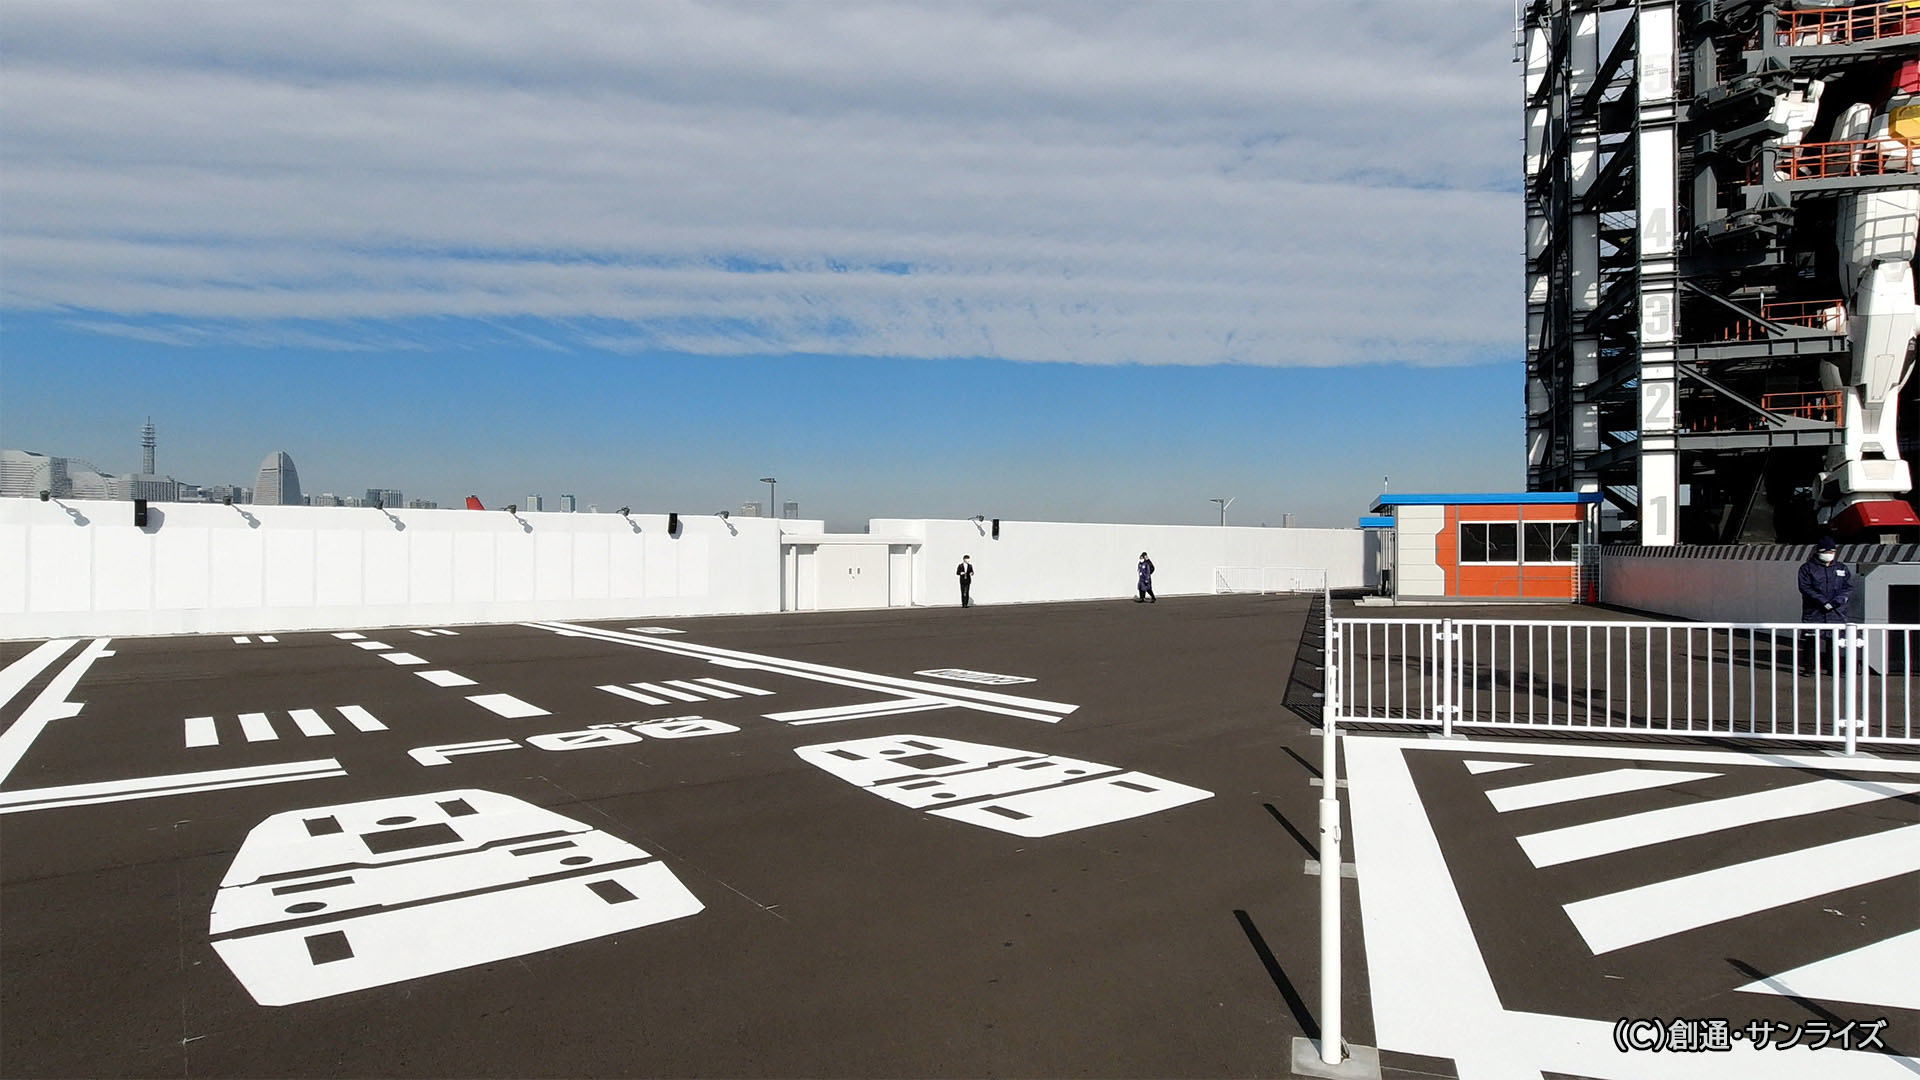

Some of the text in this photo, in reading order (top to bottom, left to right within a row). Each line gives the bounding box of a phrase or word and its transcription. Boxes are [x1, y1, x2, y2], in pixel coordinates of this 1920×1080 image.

[1643, 207, 1672, 248] 4
[1645, 295, 1670, 335] 3
[1645, 383, 1671, 424] 2
[1650, 495, 1667, 535] 1
